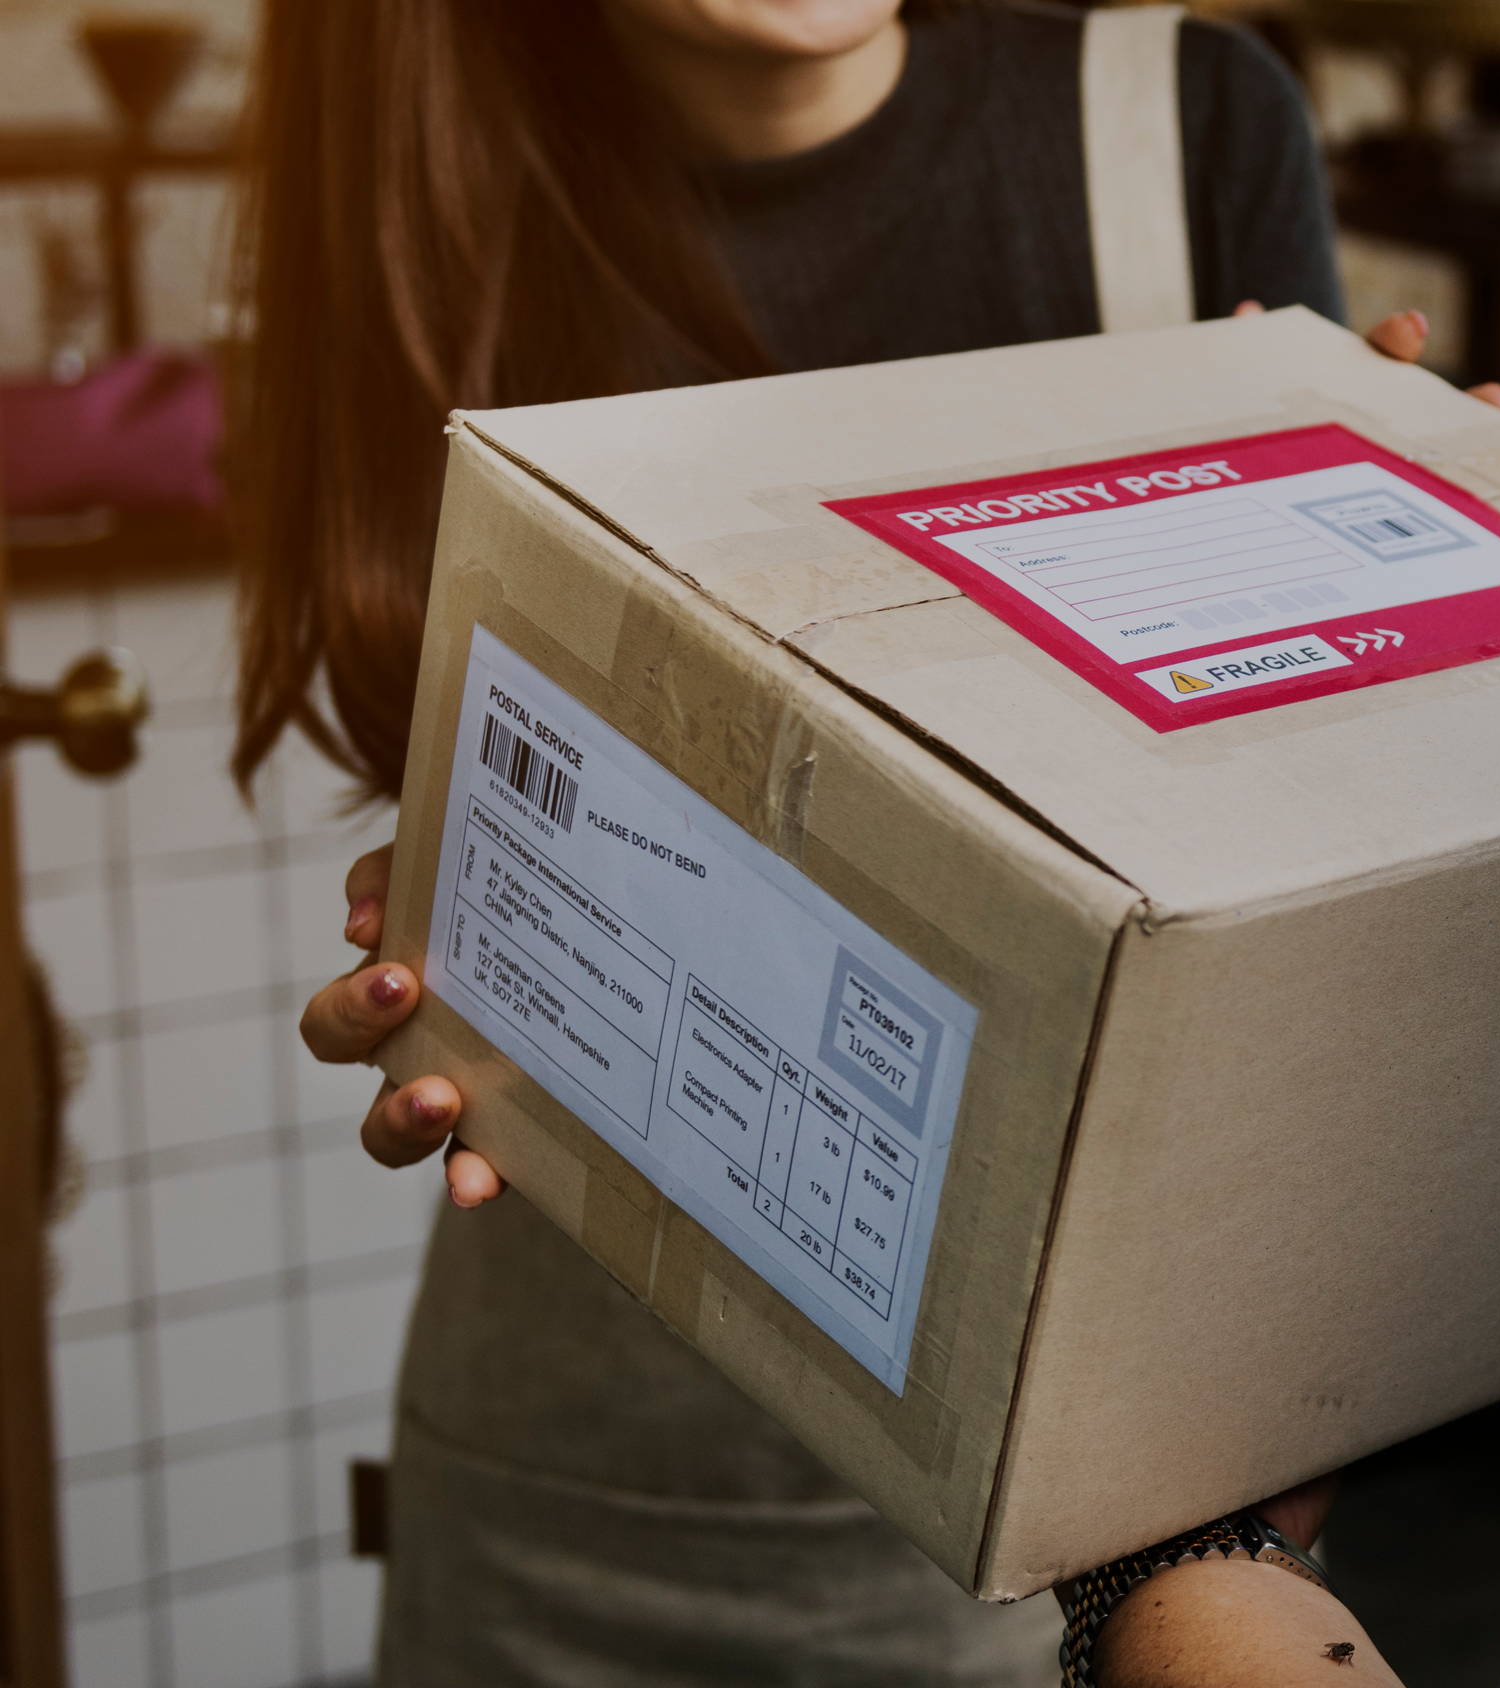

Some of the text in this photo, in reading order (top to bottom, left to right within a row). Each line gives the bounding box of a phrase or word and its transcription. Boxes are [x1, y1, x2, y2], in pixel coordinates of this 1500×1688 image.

[896, 460, 1242, 532] PRIORITY POST
[1120, 618, 1180, 637] Postcode:
[1206, 646, 1327, 682] FRAGILE
[489, 684, 584, 771] POSTAL SERVICE
[489, 779, 555, 839] 61820349-12933
[465, 844, 476, 880] FROM
[473, 806, 623, 937] Priority Package International Service
[587, 810, 707, 879] PLEASE DO NOT BEND
[458, 913, 466, 930] TO
[484, 893, 513, 927] CHINA
[489, 858, 553, 920] Mr. Kyley Chen
[473, 966, 488, 989] UK,
[486, 878, 498, 892] 47
[499, 890, 539, 930] Jiangning
[609, 979, 644, 1014] 211000
[493, 945, 533, 986] Jonathan
[534, 980, 566, 1015] Greens
[476, 950, 492, 969] 127
[494, 964, 512, 988] Oak
[528, 991, 560, 1031] Winnall,
[562, 1022, 610, 1071] Hampshire
[691, 985, 718, 1015] Detail
[718, 1007, 770, 1058] Description
[815, 1086, 849, 1122] Weight
[872, 1132, 899, 1163] Value
[848, 1034, 907, 1091] 11/02/17
[682, 1083, 715, 1117] Machine
[691, 1027, 733, 1069] Electronics
[732, 1062, 764, 1094] Adapter
[783, 1104, 789, 1116] 1
[823, 1136, 830, 1149] 3
[863, 1168, 896, 1202] $10.99
[684, 1070, 719, 1106] Compact
[719, 1099, 748, 1131] Printing
[775, 1152, 780, 1163] 1
[809, 1180, 821, 1196] 17
[853, 1217, 887, 1250] $27.75
[726, 1166, 749, 1193] Total
[763, 1199, 771, 1212] 2
[800, 1230, 812, 1246] 20
[843, 1267, 876, 1301] $38.74
